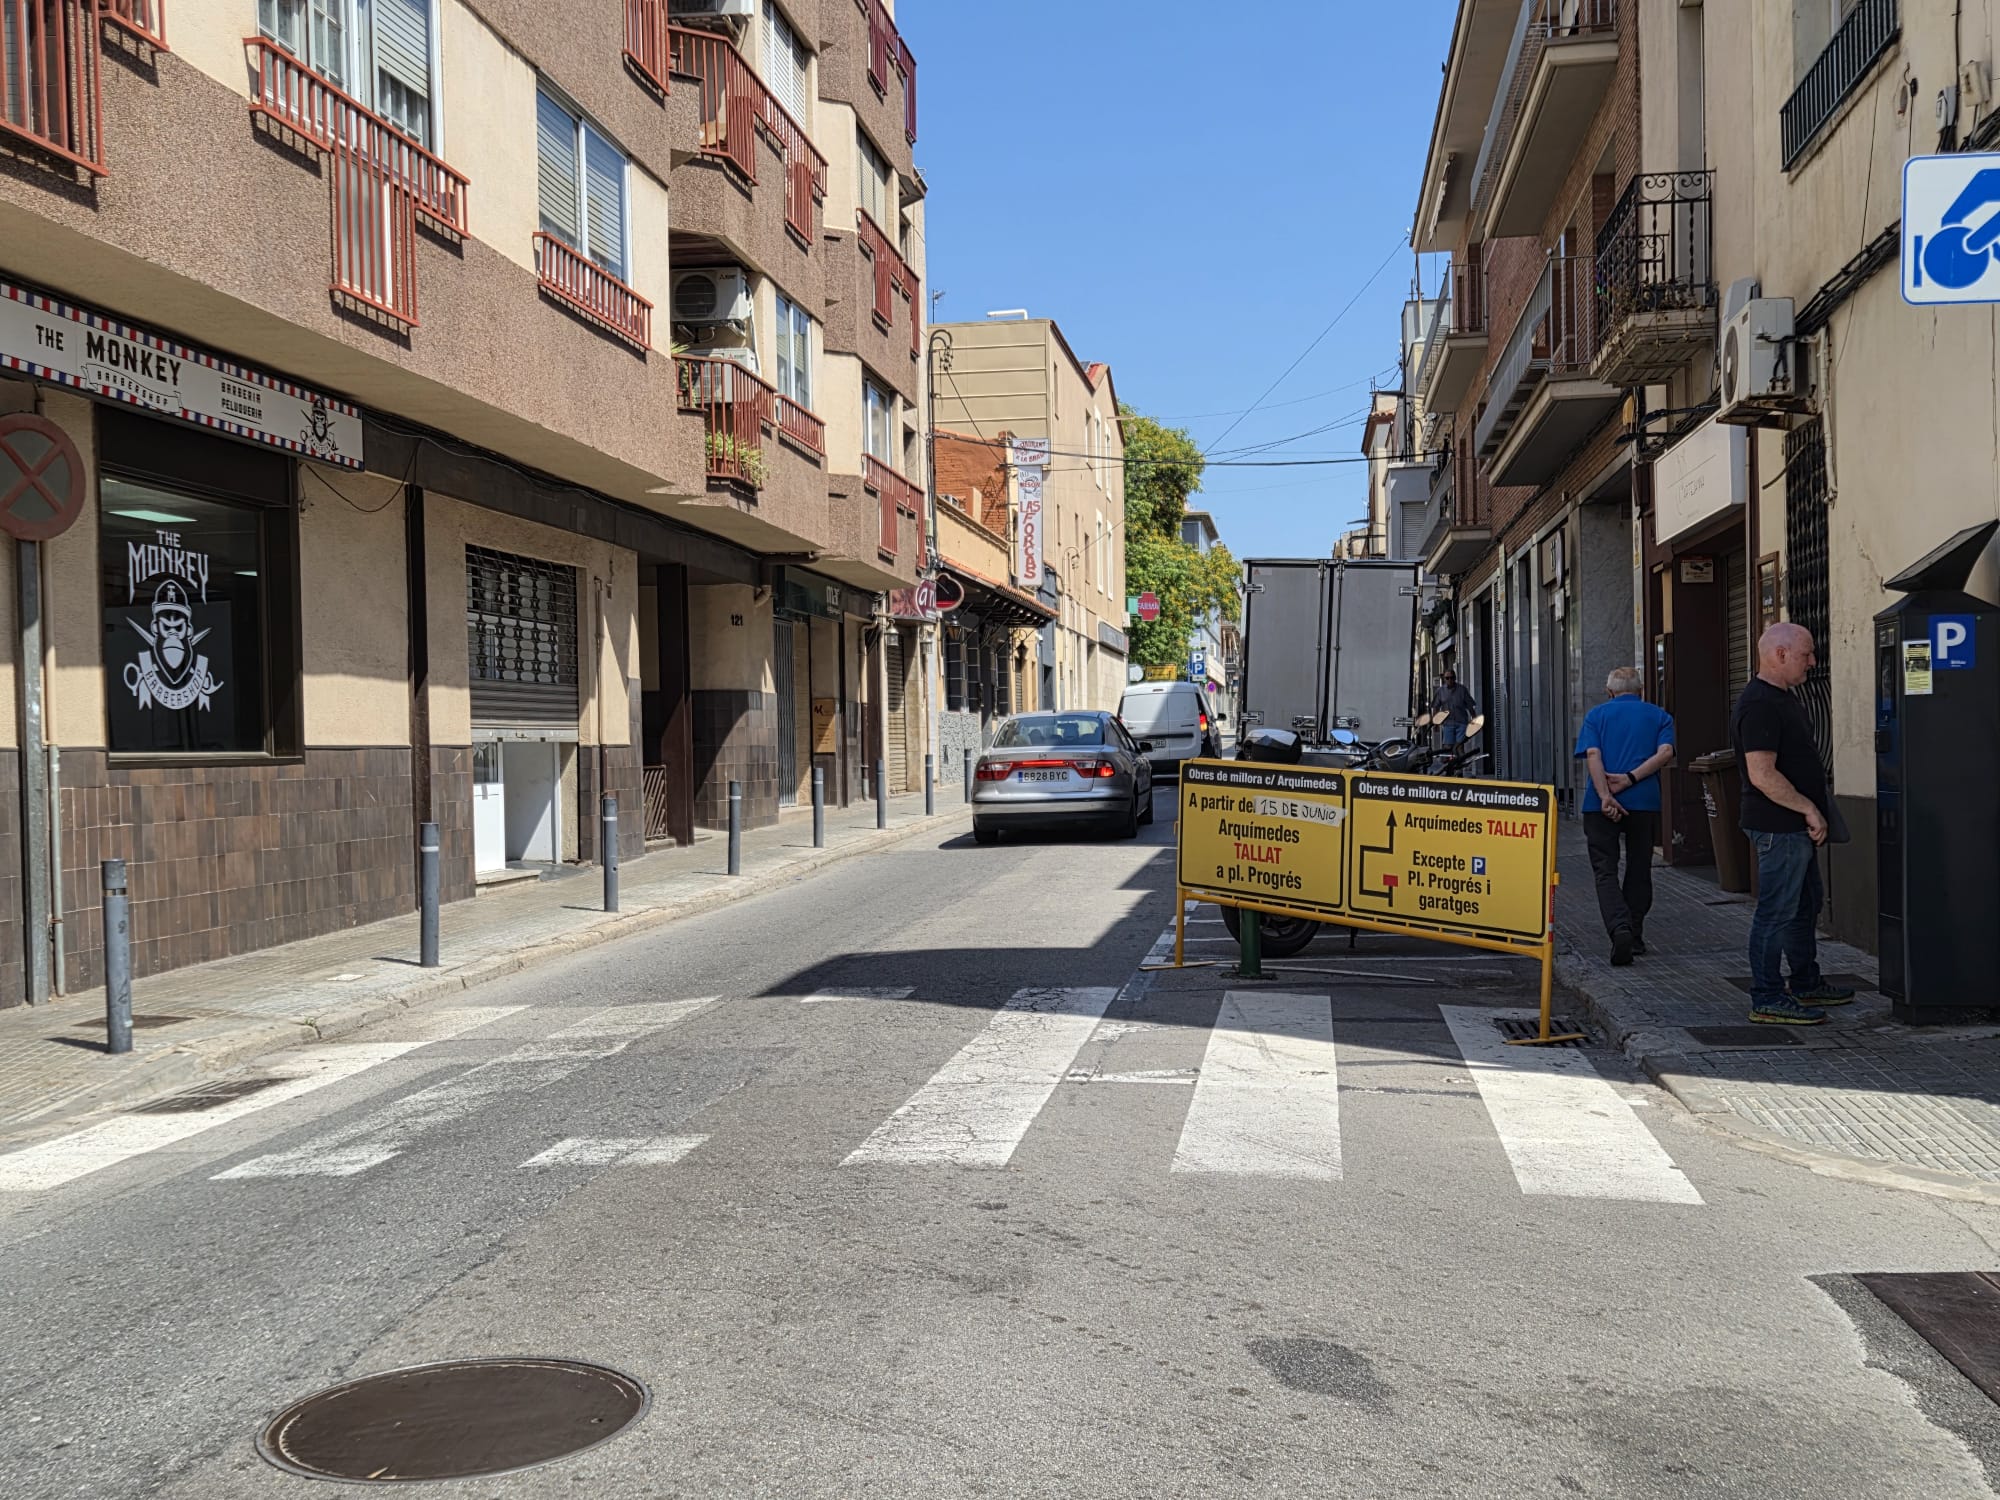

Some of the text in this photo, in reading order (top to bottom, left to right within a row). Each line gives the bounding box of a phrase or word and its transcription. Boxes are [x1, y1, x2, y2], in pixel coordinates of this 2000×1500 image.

[35, 324, 181, 386] THE MONKEY
[97, 370, 168, 405] BARBERSHOP
[1020, 500, 1041, 513] LAS
[156, 529, 181, 548] THE
[1022, 512, 1037, 580] FORCAS
[127, 541, 209, 605] MONKEY
[731, 614, 743, 626] 121
[1937, 622, 1966, 659] P
[1194, 653, 1203, 663] P
[1194, 664, 1203, 673] P
[1049, 771, 1068, 781] BYC
[1189, 768, 1337, 790] Obres de millora c/ Arquímedes
[1189, 792, 1256, 813] A partir de
[1359, 782, 1539, 807] Obres de millora c/ Arquímedes
[1260, 799, 1278, 816] 15
[1282, 802, 1298, 818] DE
[1219, 819, 1299, 843] Arquímedes
[1404, 812, 1538, 839] Arquímedes TALLAT
[1234, 843, 1282, 864] TALLAT
[1413, 850, 1484, 873] Excepte P
[1216, 865, 1302, 889] a pl. Progrés
[1407, 870, 1491, 895] Pl. Progrés i
[1419, 894, 1480, 915] garatges
